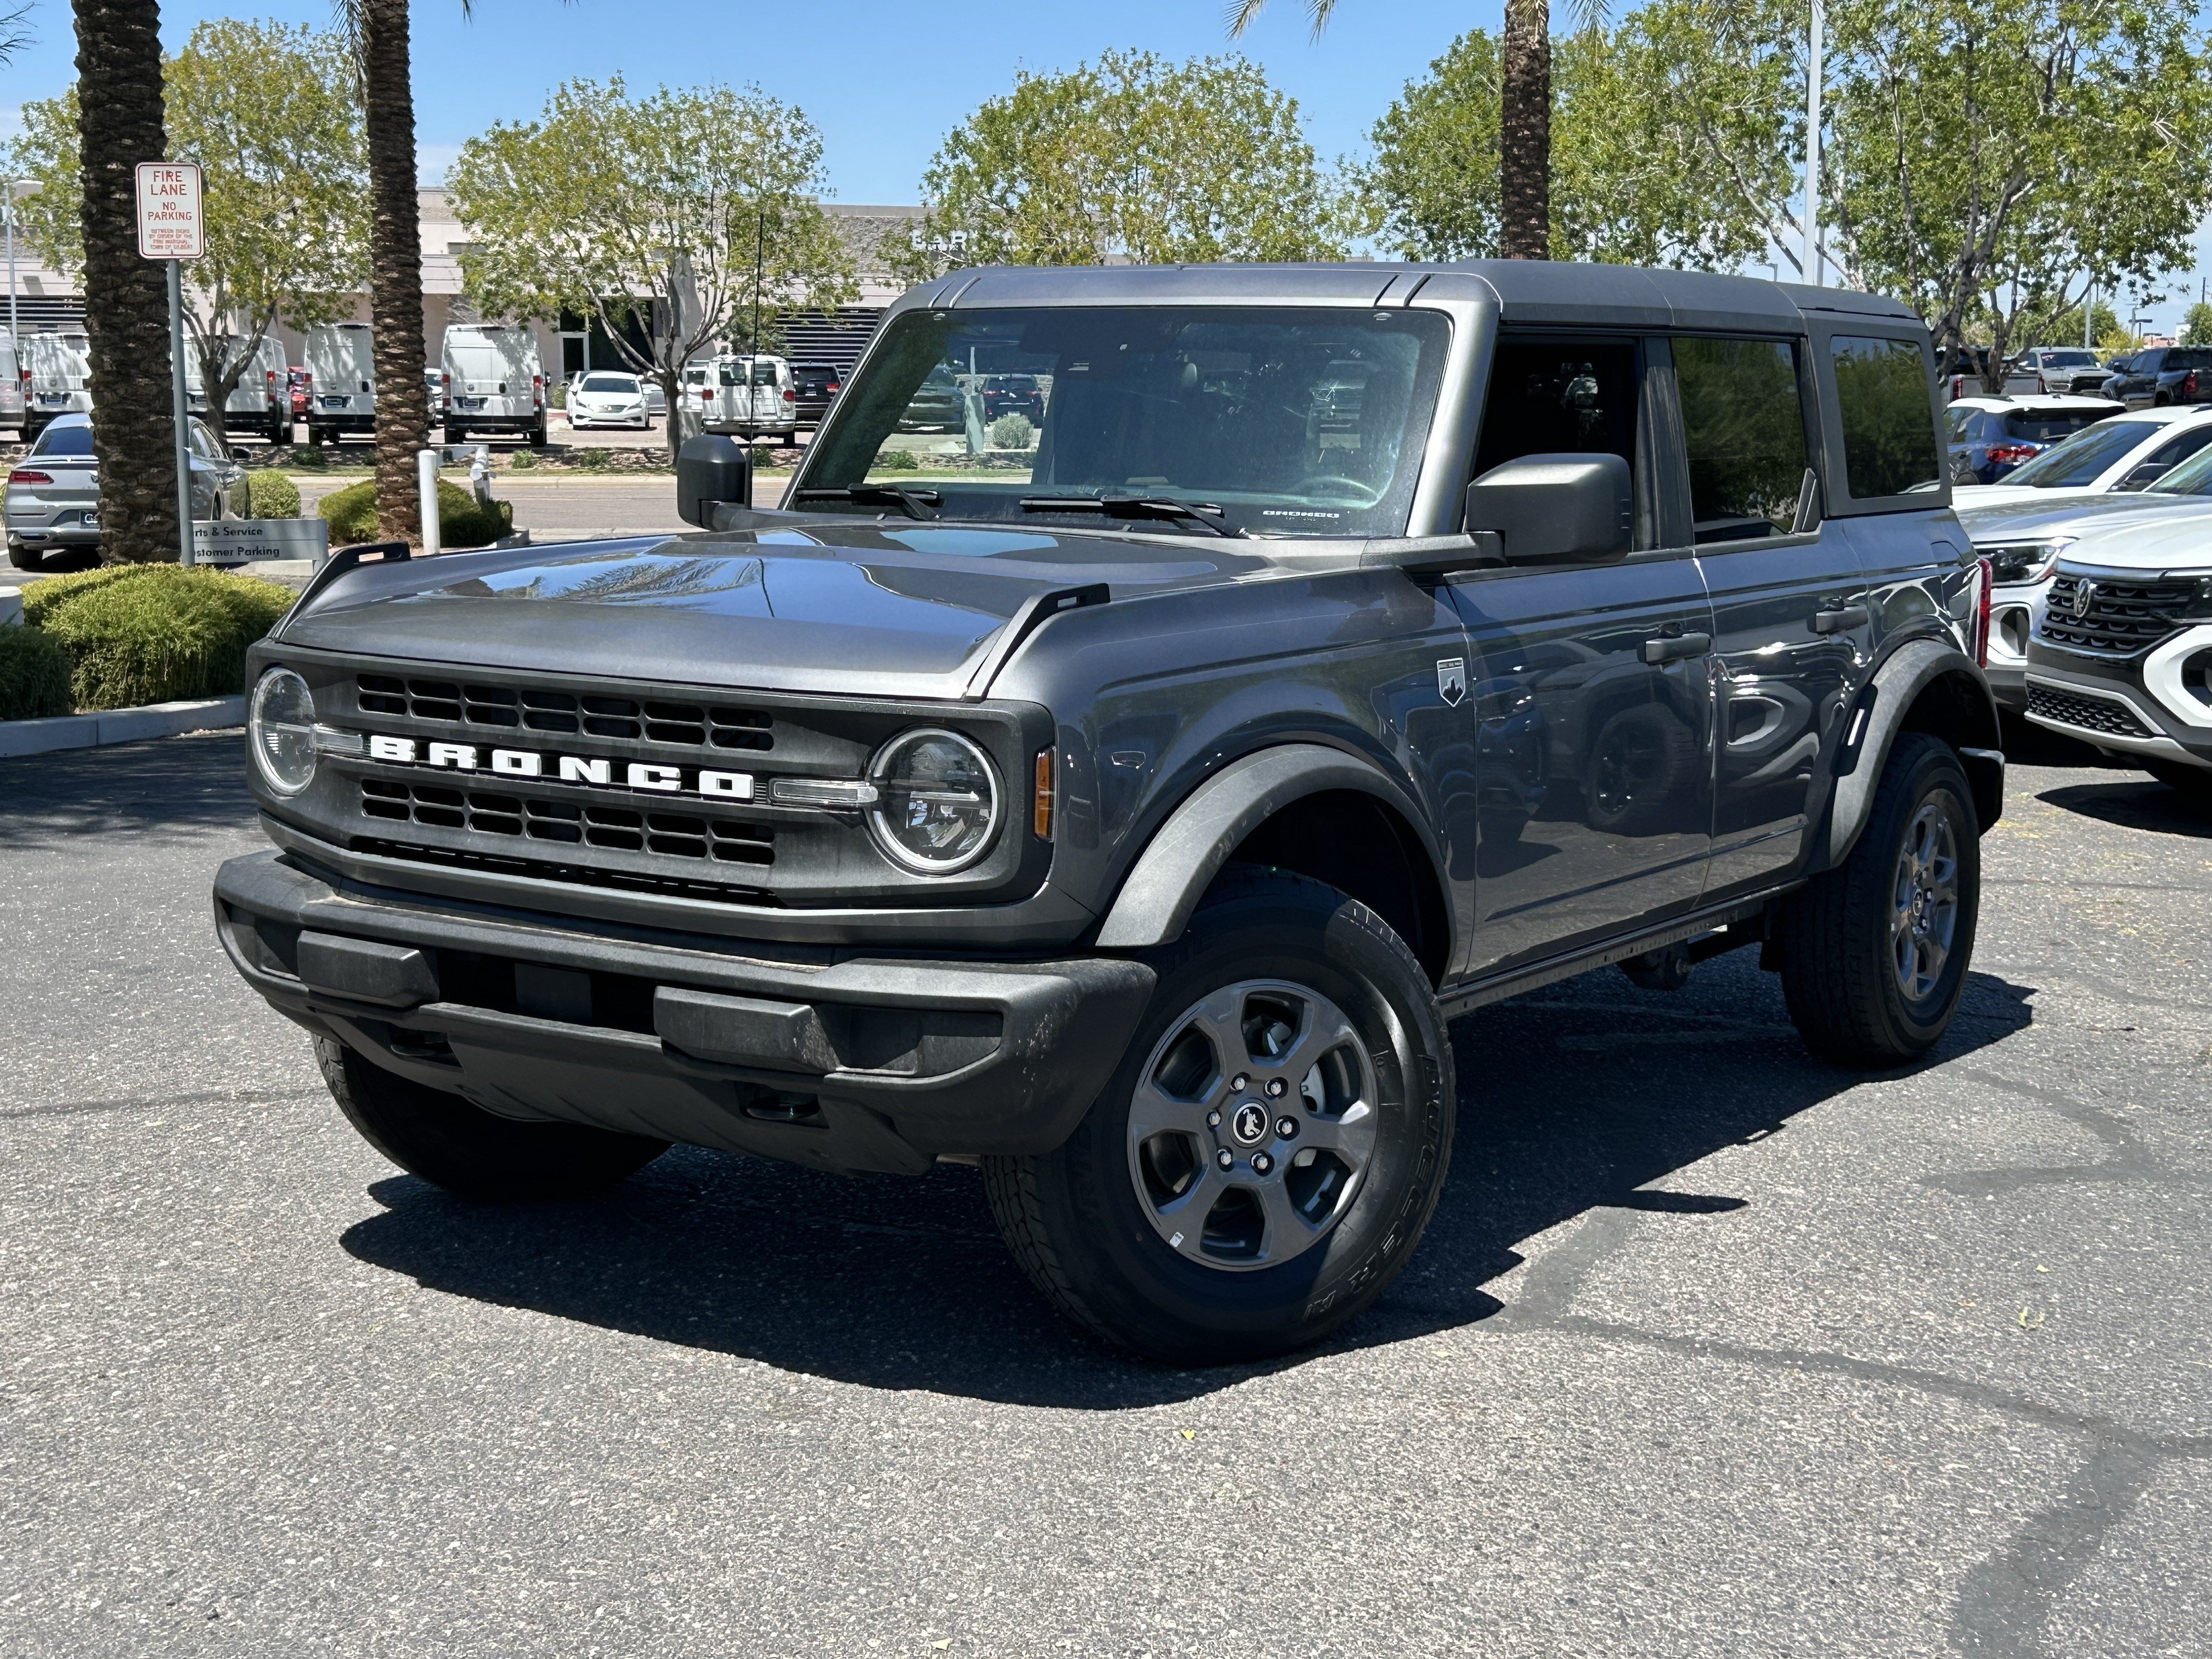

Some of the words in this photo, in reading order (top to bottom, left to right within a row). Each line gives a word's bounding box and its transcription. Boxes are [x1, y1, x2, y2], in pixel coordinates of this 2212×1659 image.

[154, 171, 183, 182] FIRE
[151, 184, 187, 195] LANE
[162, 202, 176, 211] NO
[148, 212, 191, 221] PARKING
[194, 529, 208, 537] rts
[212, 527, 219, 536] &
[223, 527, 263, 536] Service
[194, 548, 234, 557] stomer
[237, 546, 280, 557] Parking
[370, 735, 755, 799] BRONCO
